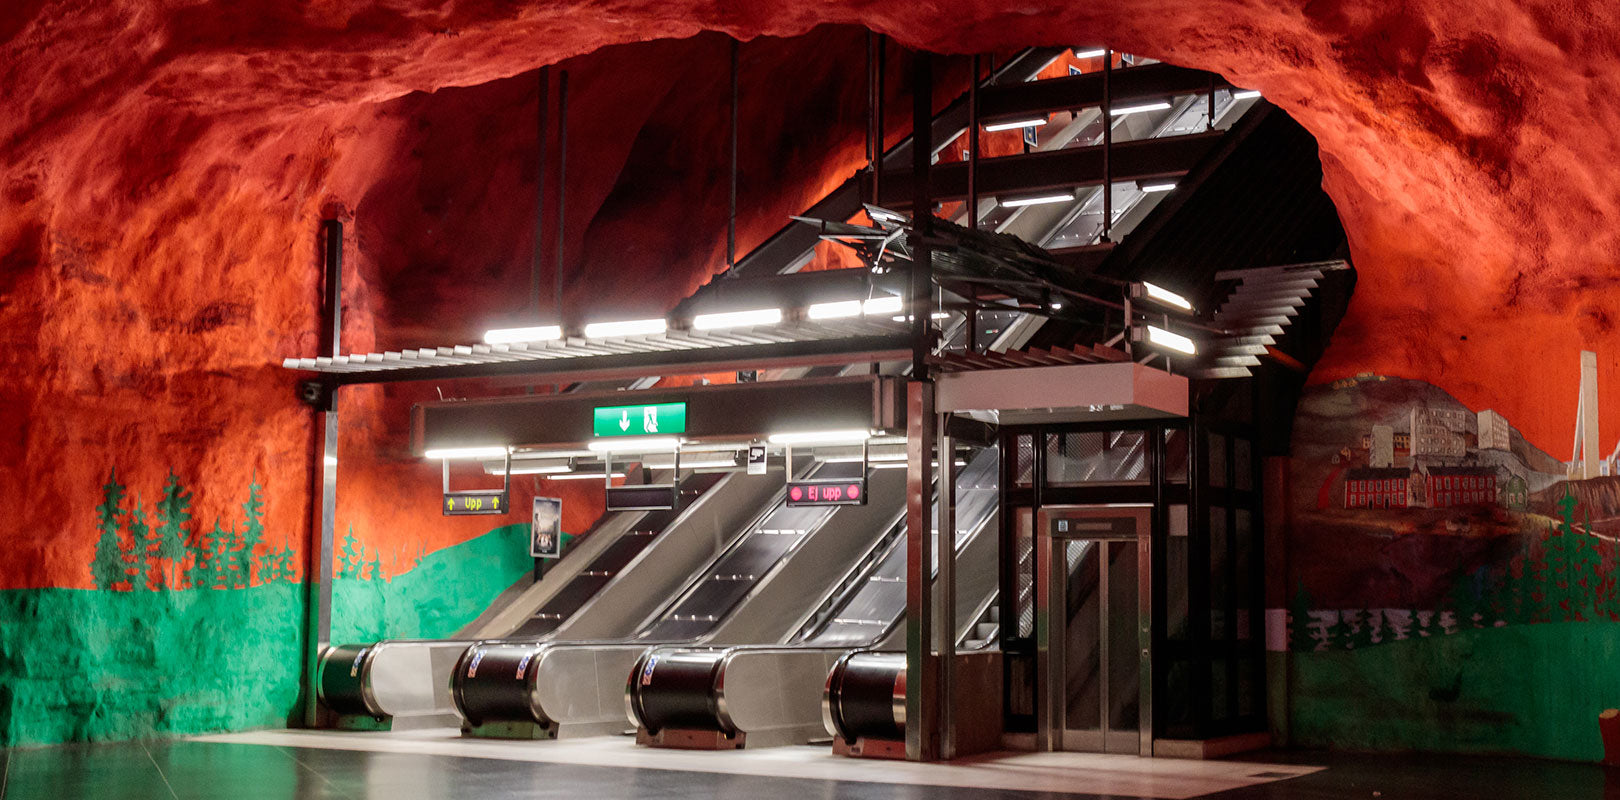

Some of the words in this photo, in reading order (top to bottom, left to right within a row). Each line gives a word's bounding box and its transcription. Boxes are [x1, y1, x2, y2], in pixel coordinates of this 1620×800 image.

[808, 485, 819, 502] Ej
[823, 486, 842, 501] upp
[465, 496, 482, 511] Upp
